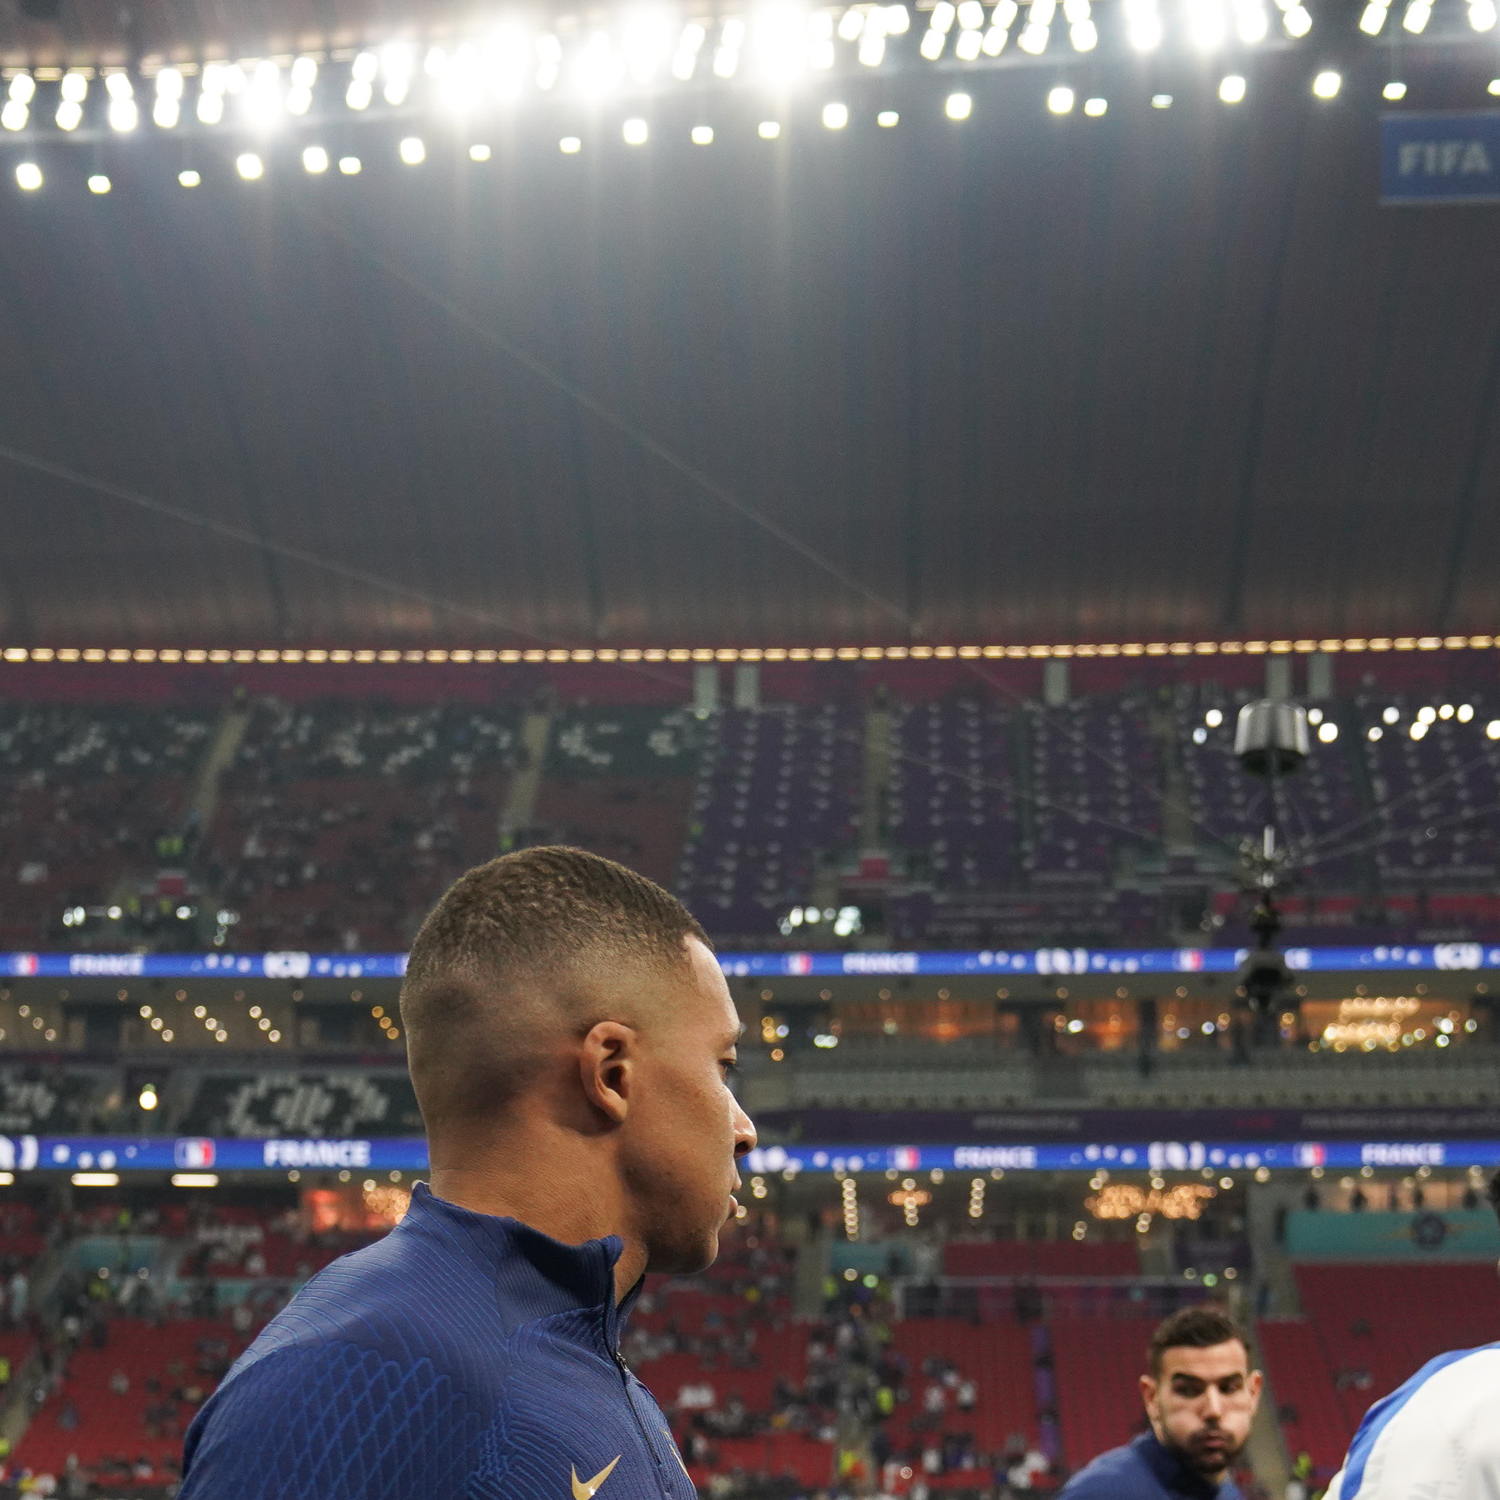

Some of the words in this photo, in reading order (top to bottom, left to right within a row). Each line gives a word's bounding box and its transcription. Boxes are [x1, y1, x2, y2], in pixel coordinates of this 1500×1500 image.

[1399, 141, 1491, 176] FIFA
[69, 953, 145, 976] FRANCE
[841, 952, 920, 974] FRANCE
[263, 1139, 371, 1168] FRANCE
[953, 1146, 1037, 1169] FRANCE
[1361, 1143, 1445, 1166] FRANCE
